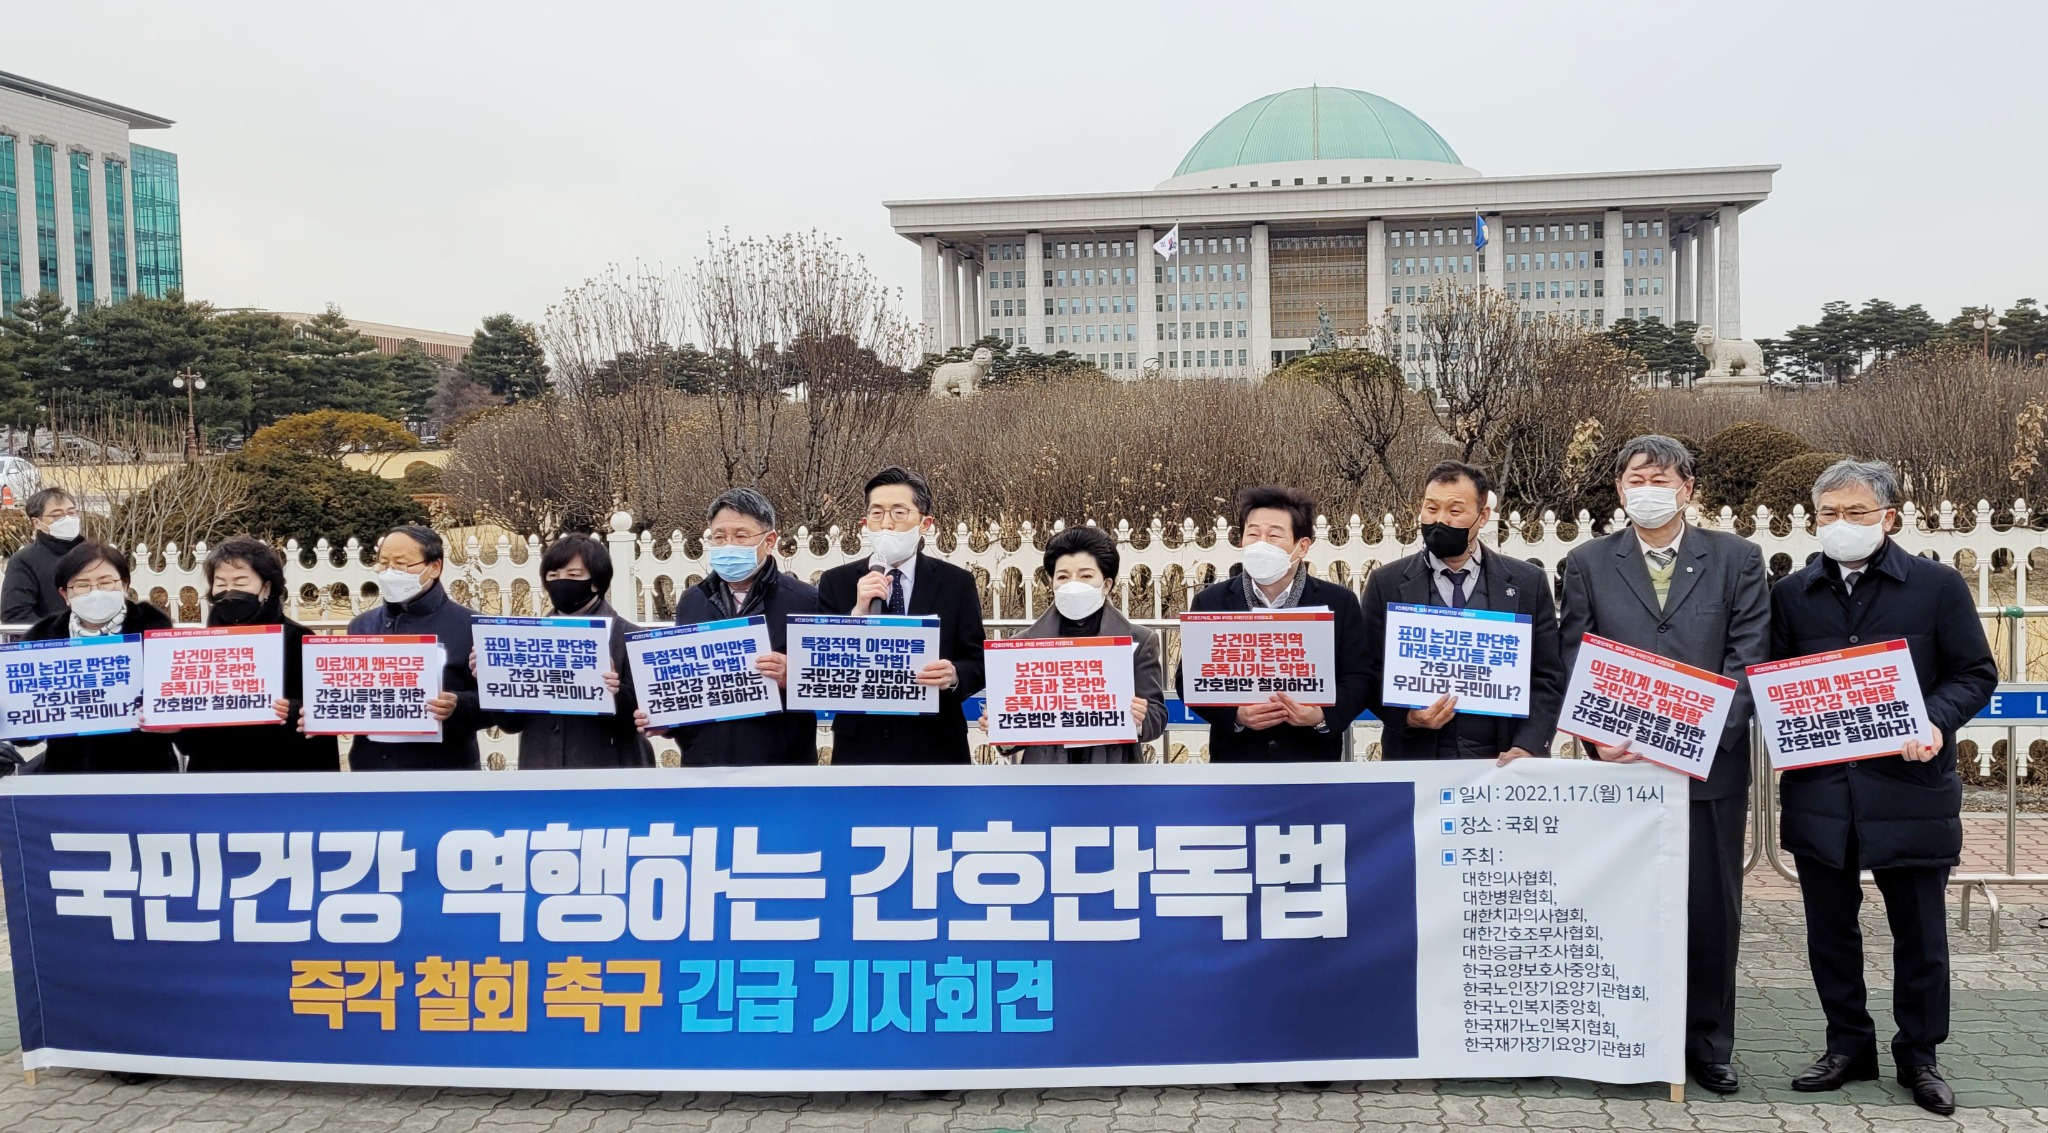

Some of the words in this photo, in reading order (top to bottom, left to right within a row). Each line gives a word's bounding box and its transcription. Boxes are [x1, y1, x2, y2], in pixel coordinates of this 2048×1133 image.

[484, 637, 510, 651] 표의
[514, 638, 554, 653] 논리로
[557, 639, 597, 654] 판단한
[801, 637, 861, 651] 특정직역
[866, 639, 925, 653] 이익만을
[1213, 633, 1303, 647] 보건의료직역
[1398, 626, 1426, 642] 표의
[1430, 628, 1472, 647] 논리로
[1477, 633, 1520, 650] 판단한
[172, 647, 254, 664] 보건의료직역
[488, 653, 567, 669] 대권후보자들
[570, 655, 597, 669] 공약
[642, 647, 698, 666] 특정직역
[701, 639, 757, 659] 이익만을
[811, 653, 870, 668] 대변하는
[875, 654, 910, 669] 악법!
[1211, 649, 1256, 662] 갈등과
[1260, 648, 1306, 662] 혼란만
[1399, 642, 1485, 664] 대권후보자들
[1489, 651, 1518, 667] 공약
[6, 663, 35, 678] 표의
[39, 659, 83, 675] 논리로
[86, 655, 131, 672] 판단한
[171, 665, 211, 680] 갈등과
[215, 663, 256, 678] 혼란만
[316, 656, 368, 671] 의료체계
[372, 657, 424, 671] 왜곡으로
[653, 662, 710, 681] 대변하는
[713, 656, 747, 673] 악법!
[1016, 660, 1103, 678] 보건의료직역
[1201, 663, 1276, 677] 증폭시키는
[1280, 664, 1316, 677] 악법!
[1420, 661, 1492, 681] 간호사들만
[9, 674, 97, 694] 대권후보자들
[101, 671, 130, 686] 공약
[322, 673, 375, 687] 국민건강
[379, 672, 418, 687] 위협할
[508, 668, 575, 684] 간호사들만
[648, 678, 703, 697] 국민건강
[707, 672, 763, 690] 외면하는
[801, 668, 861, 683] 국민건강
[1767, 677, 1831, 702] 의료체계
[1833, 666, 1901, 691] 왜곡으로
[161, 681, 228, 696] 증폭시키는
[232, 679, 265, 693] 악법!
[486, 683, 539, 698] 우리나라
[542, 685, 604, 700] 국민이냐?
[797, 683, 857, 699] 간호법안
[861, 686, 926, 700] 철회하라!
[1014, 679, 1058, 694] 갈등과
[1062, 677, 1106, 693] 혼란만
[1194, 678, 1254, 692] 간호법안
[1258, 678, 1324, 692] 철회하라!
[1393, 675, 1451, 694] 우리나라
[1455, 681, 1521, 701] 국민이냐?
[1589, 659, 1652, 691] 의료체계
[1652, 680, 1716, 713] 왜곡으로
[32, 689, 106, 708] 간호사들만
[153, 697, 208, 713] 간호법안
[212, 694, 272, 711] 철회하라!
[316, 688, 395, 702] 간호사들만을
[399, 688, 425, 702] 위한
[648, 695, 703, 714] 간호법안
[706, 686, 768, 707] 철회하라!
[1005, 695, 1078, 712] 증폭시키는
[1081, 694, 1116, 710] 악법!
[1593, 677, 1654, 710] 국민건강
[1656, 698, 1704, 726] 위협할
[1780, 694, 1843, 716] 국민건강
[1847, 684, 1896, 705] 위협할
[7, 707, 66, 725] 우리나라
[70, 702, 136, 719] 국민이냐?
[313, 704, 366, 719] 간호법안
[370, 704, 428, 719] 철회하라!
[999, 712, 1056, 729] 간호법안
[1060, 711, 1125, 728] 철회하라!
[1580, 690, 1671, 733] 간호사들만을
[1674, 721, 1706, 745] 위한
[1776, 706, 1873, 736] 간호사들만을
[1876, 701, 1909, 720] 위한
[1572, 705, 1633, 737] 간호법안
[1635, 726, 1704, 762] 철회하라!
[1777, 729, 1841, 753] 간호법안
[1845, 718, 1918, 745] 철회하라!
[1459, 785, 1492, 803] 일시
[1505, 784, 1621, 803] 2022.1.17.(월)
[1626, 785, 1664, 803] 14시
[1460, 816, 1493, 835] 장소
[1505, 816, 1539, 834] 국회
[1543, 816, 1560, 834] 앞
[1462, 848, 1494, 866] 주최
[49, 829, 416, 943] 국민건강
[437, 822, 826, 942] 역행하는
[850, 820, 1348, 941] 간호단독법
[1463, 871, 1557, 886] 대한의사협회,
[1463, 889, 1557, 906] 대한병원협회,
[1464, 908, 1587, 923] 대한치과의사협회,
[1463, 926, 1603, 941] 대한간호조무사협회,
[1463, 944, 1603, 961] 대한응급구조사협회,
[1462, 963, 1619, 980] 한국요양보호사중앙회,
[289, 959, 405, 1030] 즉각
[415, 955, 530, 1032] 철회
[543, 955, 663, 1033] 촉구
[678, 958, 798, 1033] 긴급
[813, 956, 1053, 1033] 기자회견
[1463, 981, 1649, 1001] 한국노인장기요양기관협회,
[1463, 1000, 1605, 1017] 한국노인복지중앙회,
[1464, 1018, 1620, 1039] 한국재가노인복지협회,
[1464, 1036, 1645, 1058] 한국재가장기요양기관협회
